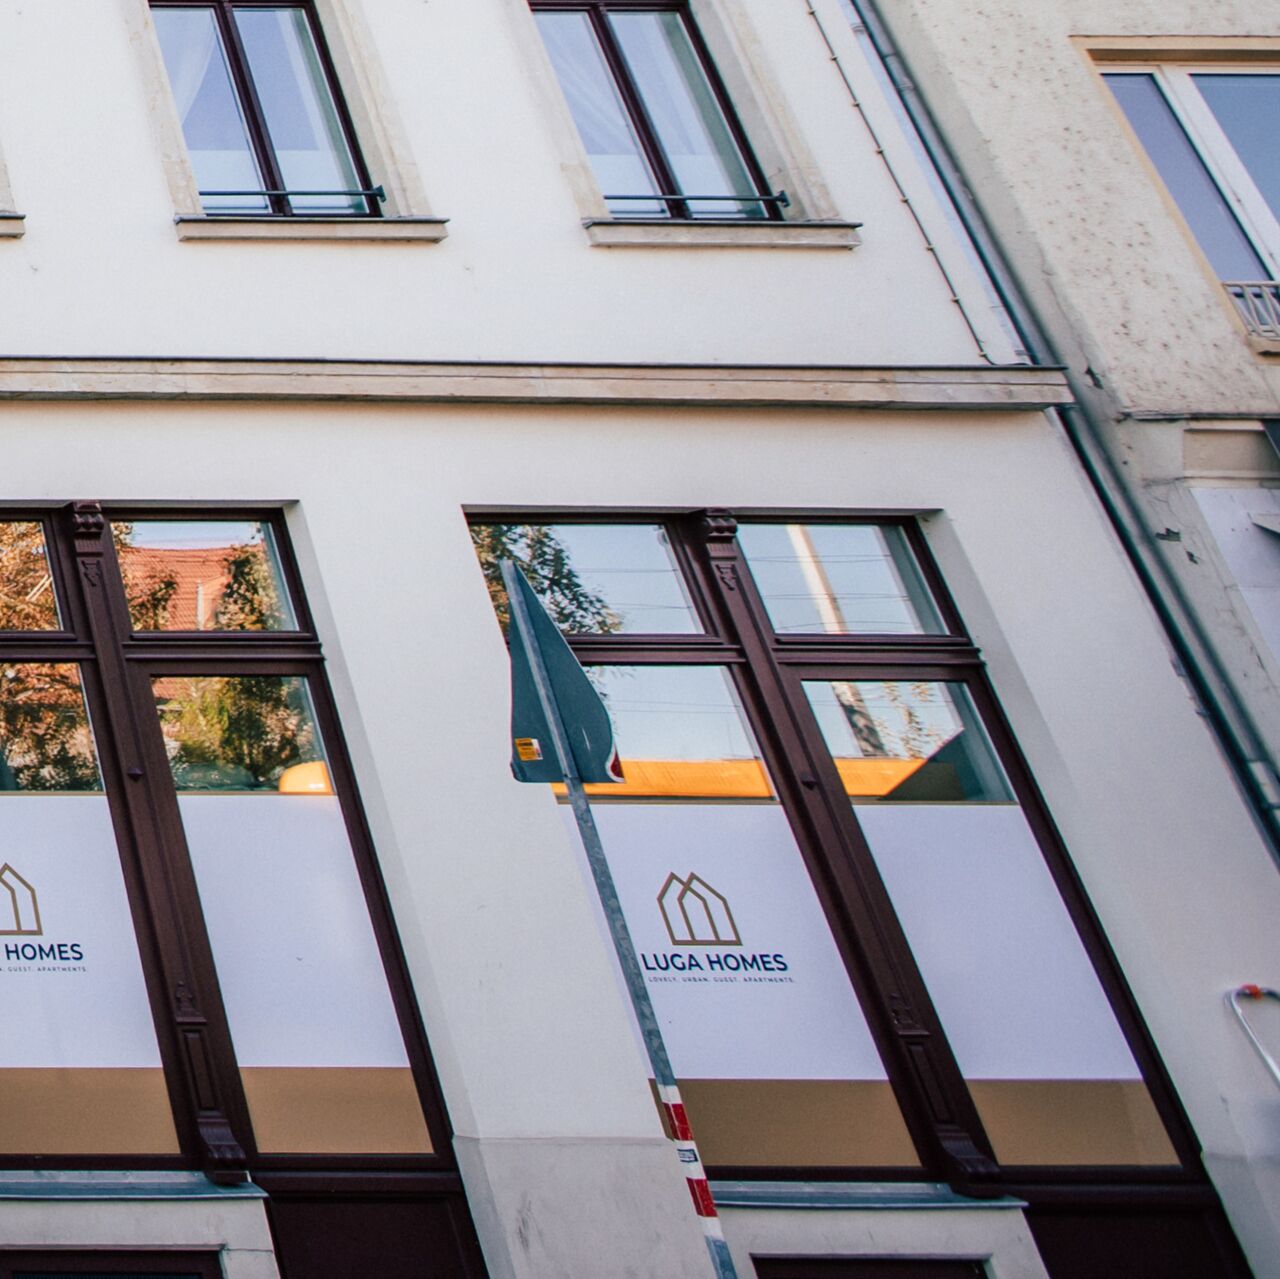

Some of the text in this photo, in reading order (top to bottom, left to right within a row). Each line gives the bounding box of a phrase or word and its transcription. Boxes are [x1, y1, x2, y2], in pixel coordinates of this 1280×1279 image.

[4, 943, 84, 961] HOMES
[640, 953, 788, 971] LUGA HOMES
